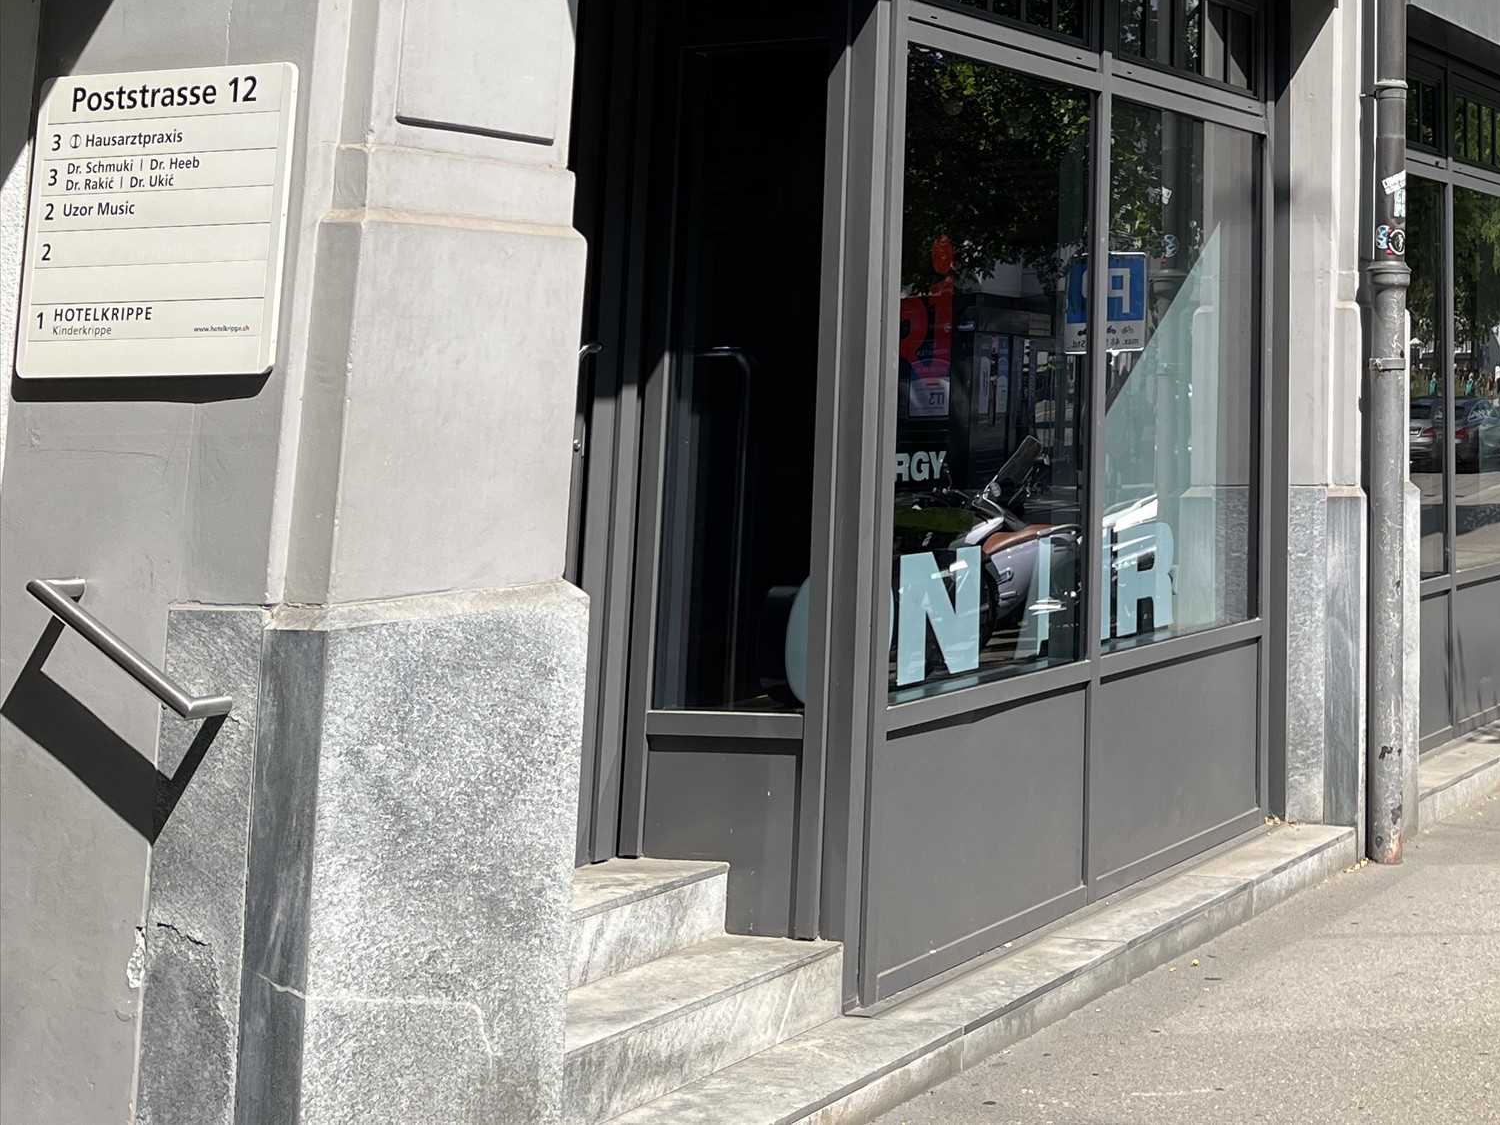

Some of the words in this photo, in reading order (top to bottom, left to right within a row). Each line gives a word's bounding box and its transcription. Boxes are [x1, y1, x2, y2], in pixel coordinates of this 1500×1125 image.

[72, 84, 217, 112] Poststrasse
[228, 76, 258, 103] 12
[51, 134, 62, 151] 3
[85, 129, 184, 149] Hausarztpraxis
[66, 162, 82, 175] Dr.
[85, 158, 134, 175] Schmuki
[149, 159, 166, 171] Dr.
[169, 156, 200, 170] Heeb
[48, 169, 58, 186] 3
[65, 178, 81, 191] Dr.
[84, 176, 114, 191] Rakić
[129, 176, 146, 189] Dr.
[149, 173, 174, 188] Ukić
[44, 203, 55, 221] 2
[62, 203, 94, 217] Uzor
[97, 201, 136, 216] Music
[41, 244, 52, 261] 2
[36, 312, 44, 329] 1
[53, 307, 153, 322] HOTELKRIPPE
[52, 325, 112, 337] Kinderkrippe
